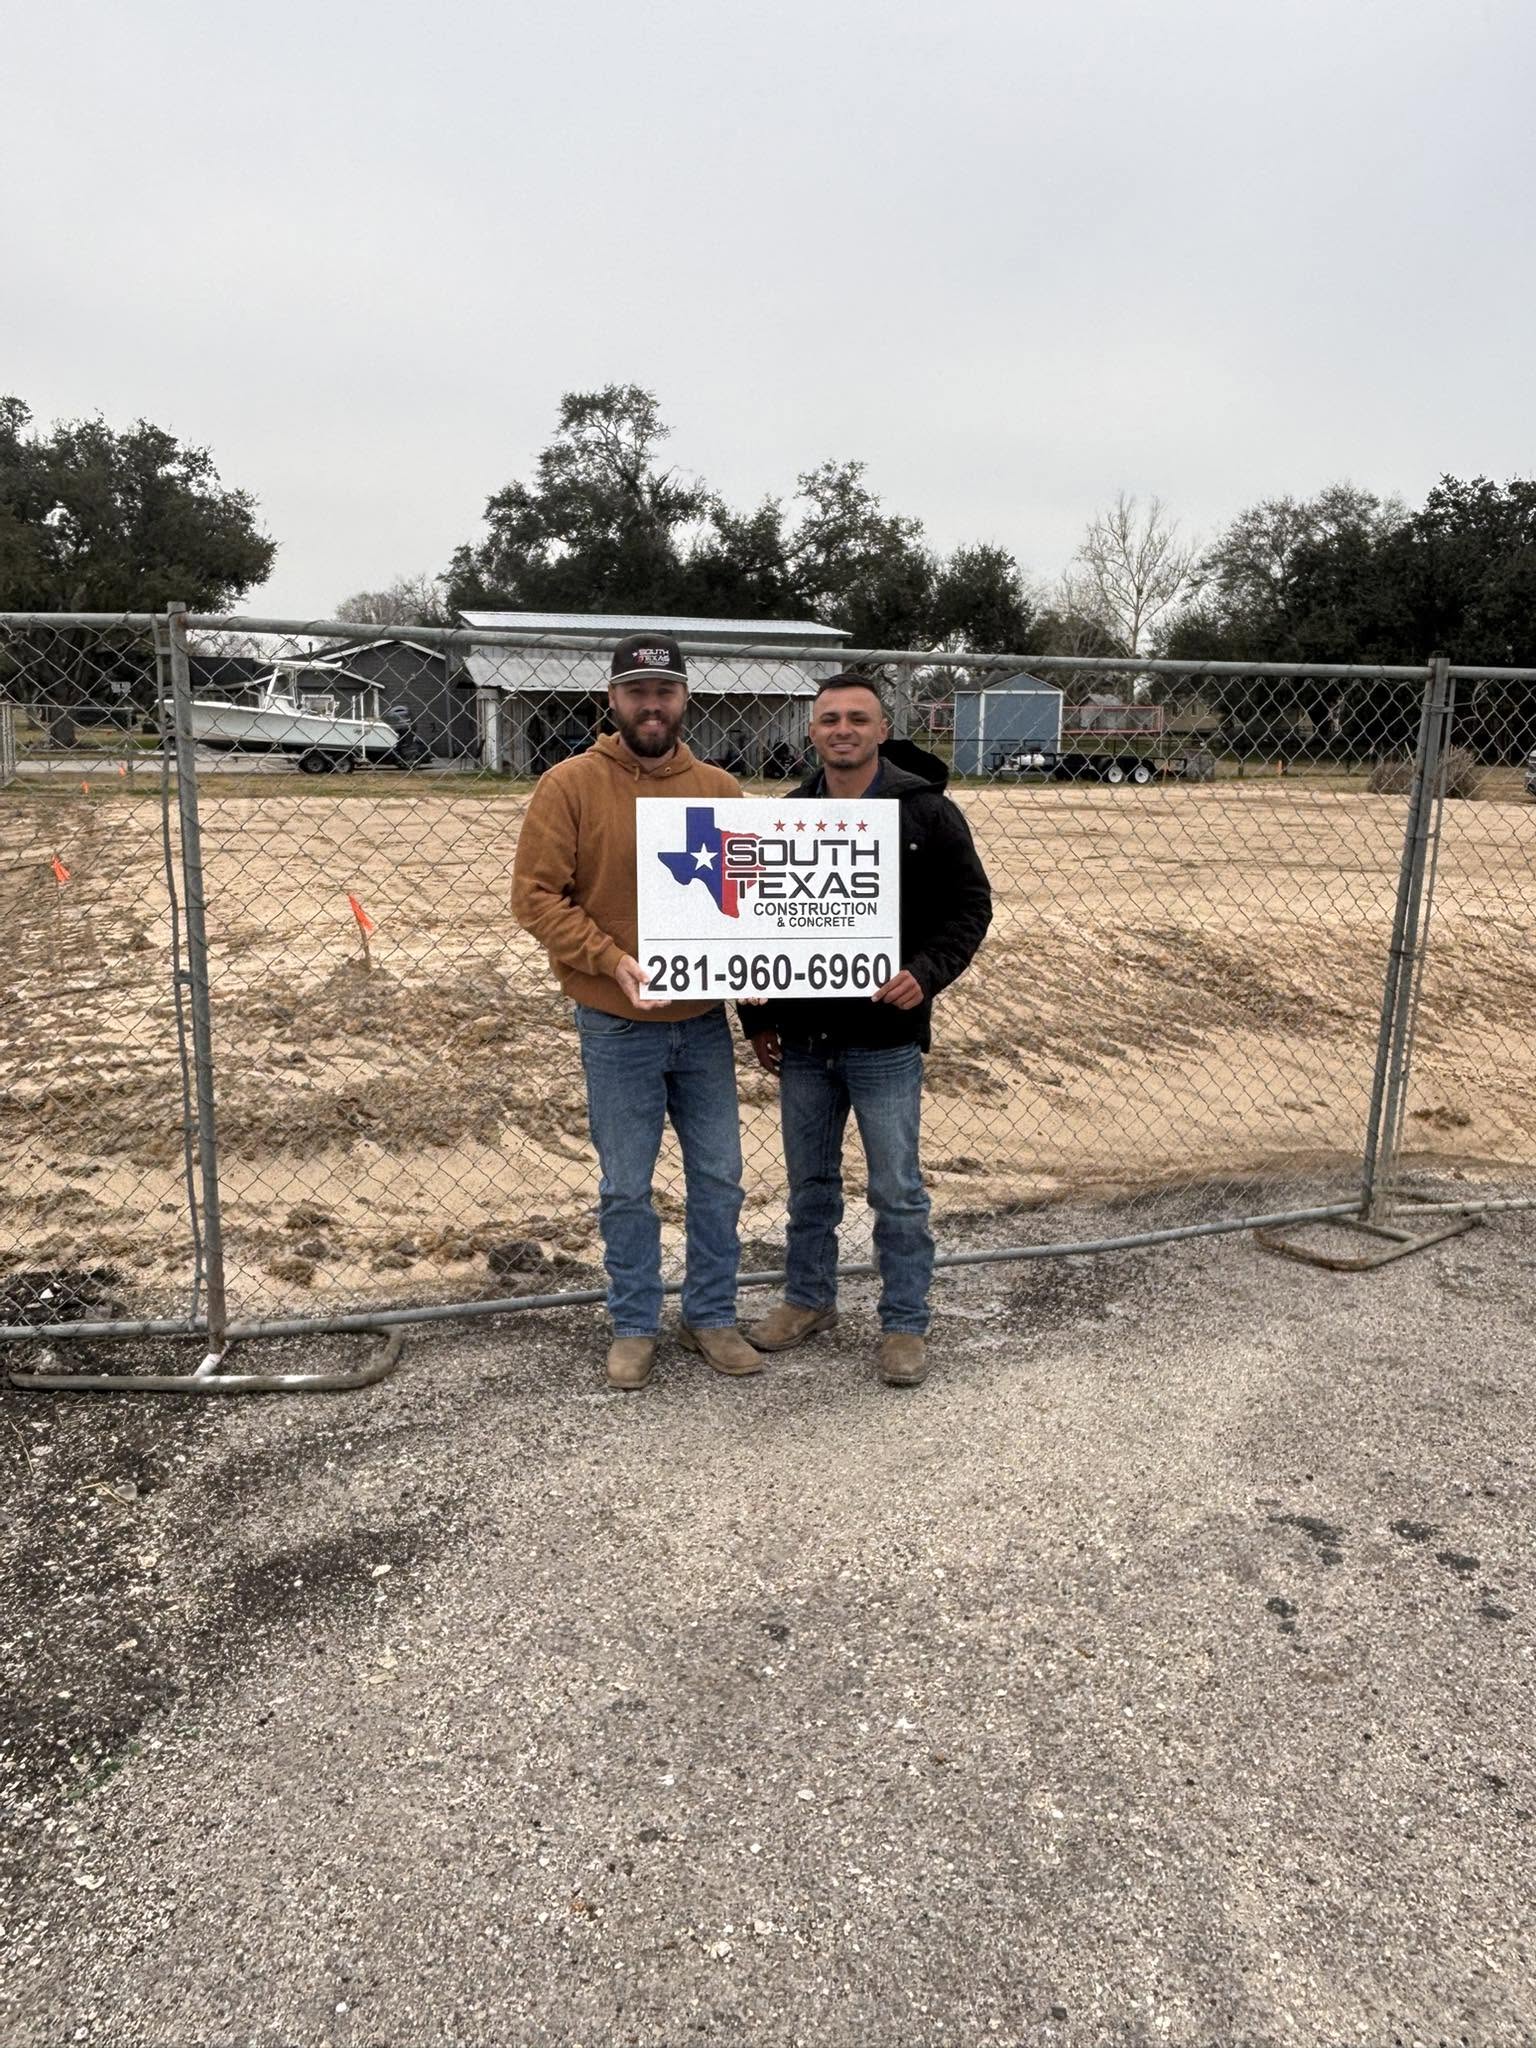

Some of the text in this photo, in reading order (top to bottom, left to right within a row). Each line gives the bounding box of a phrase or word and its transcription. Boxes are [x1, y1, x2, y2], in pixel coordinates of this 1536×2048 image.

[726, 839, 880, 866] SOUTH
[726, 872, 880, 899] TEXAS
[753, 902, 878, 916] CONSTRUCTION
[776, 916, 856, 928] & CONCRETE
[647, 953, 891, 992] 281-960-6960
